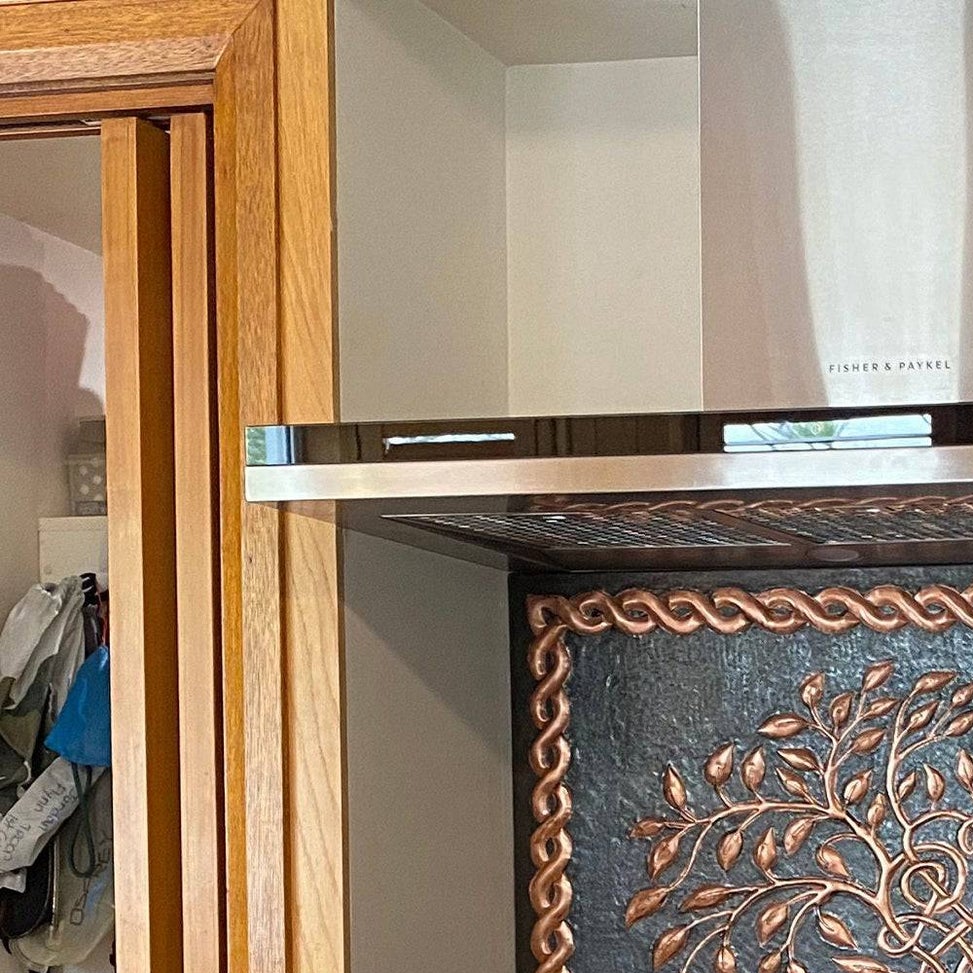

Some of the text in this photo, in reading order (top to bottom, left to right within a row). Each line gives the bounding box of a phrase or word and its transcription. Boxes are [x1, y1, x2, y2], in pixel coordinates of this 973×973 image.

[829, 360, 951, 373] FISHER & PAYKEL
